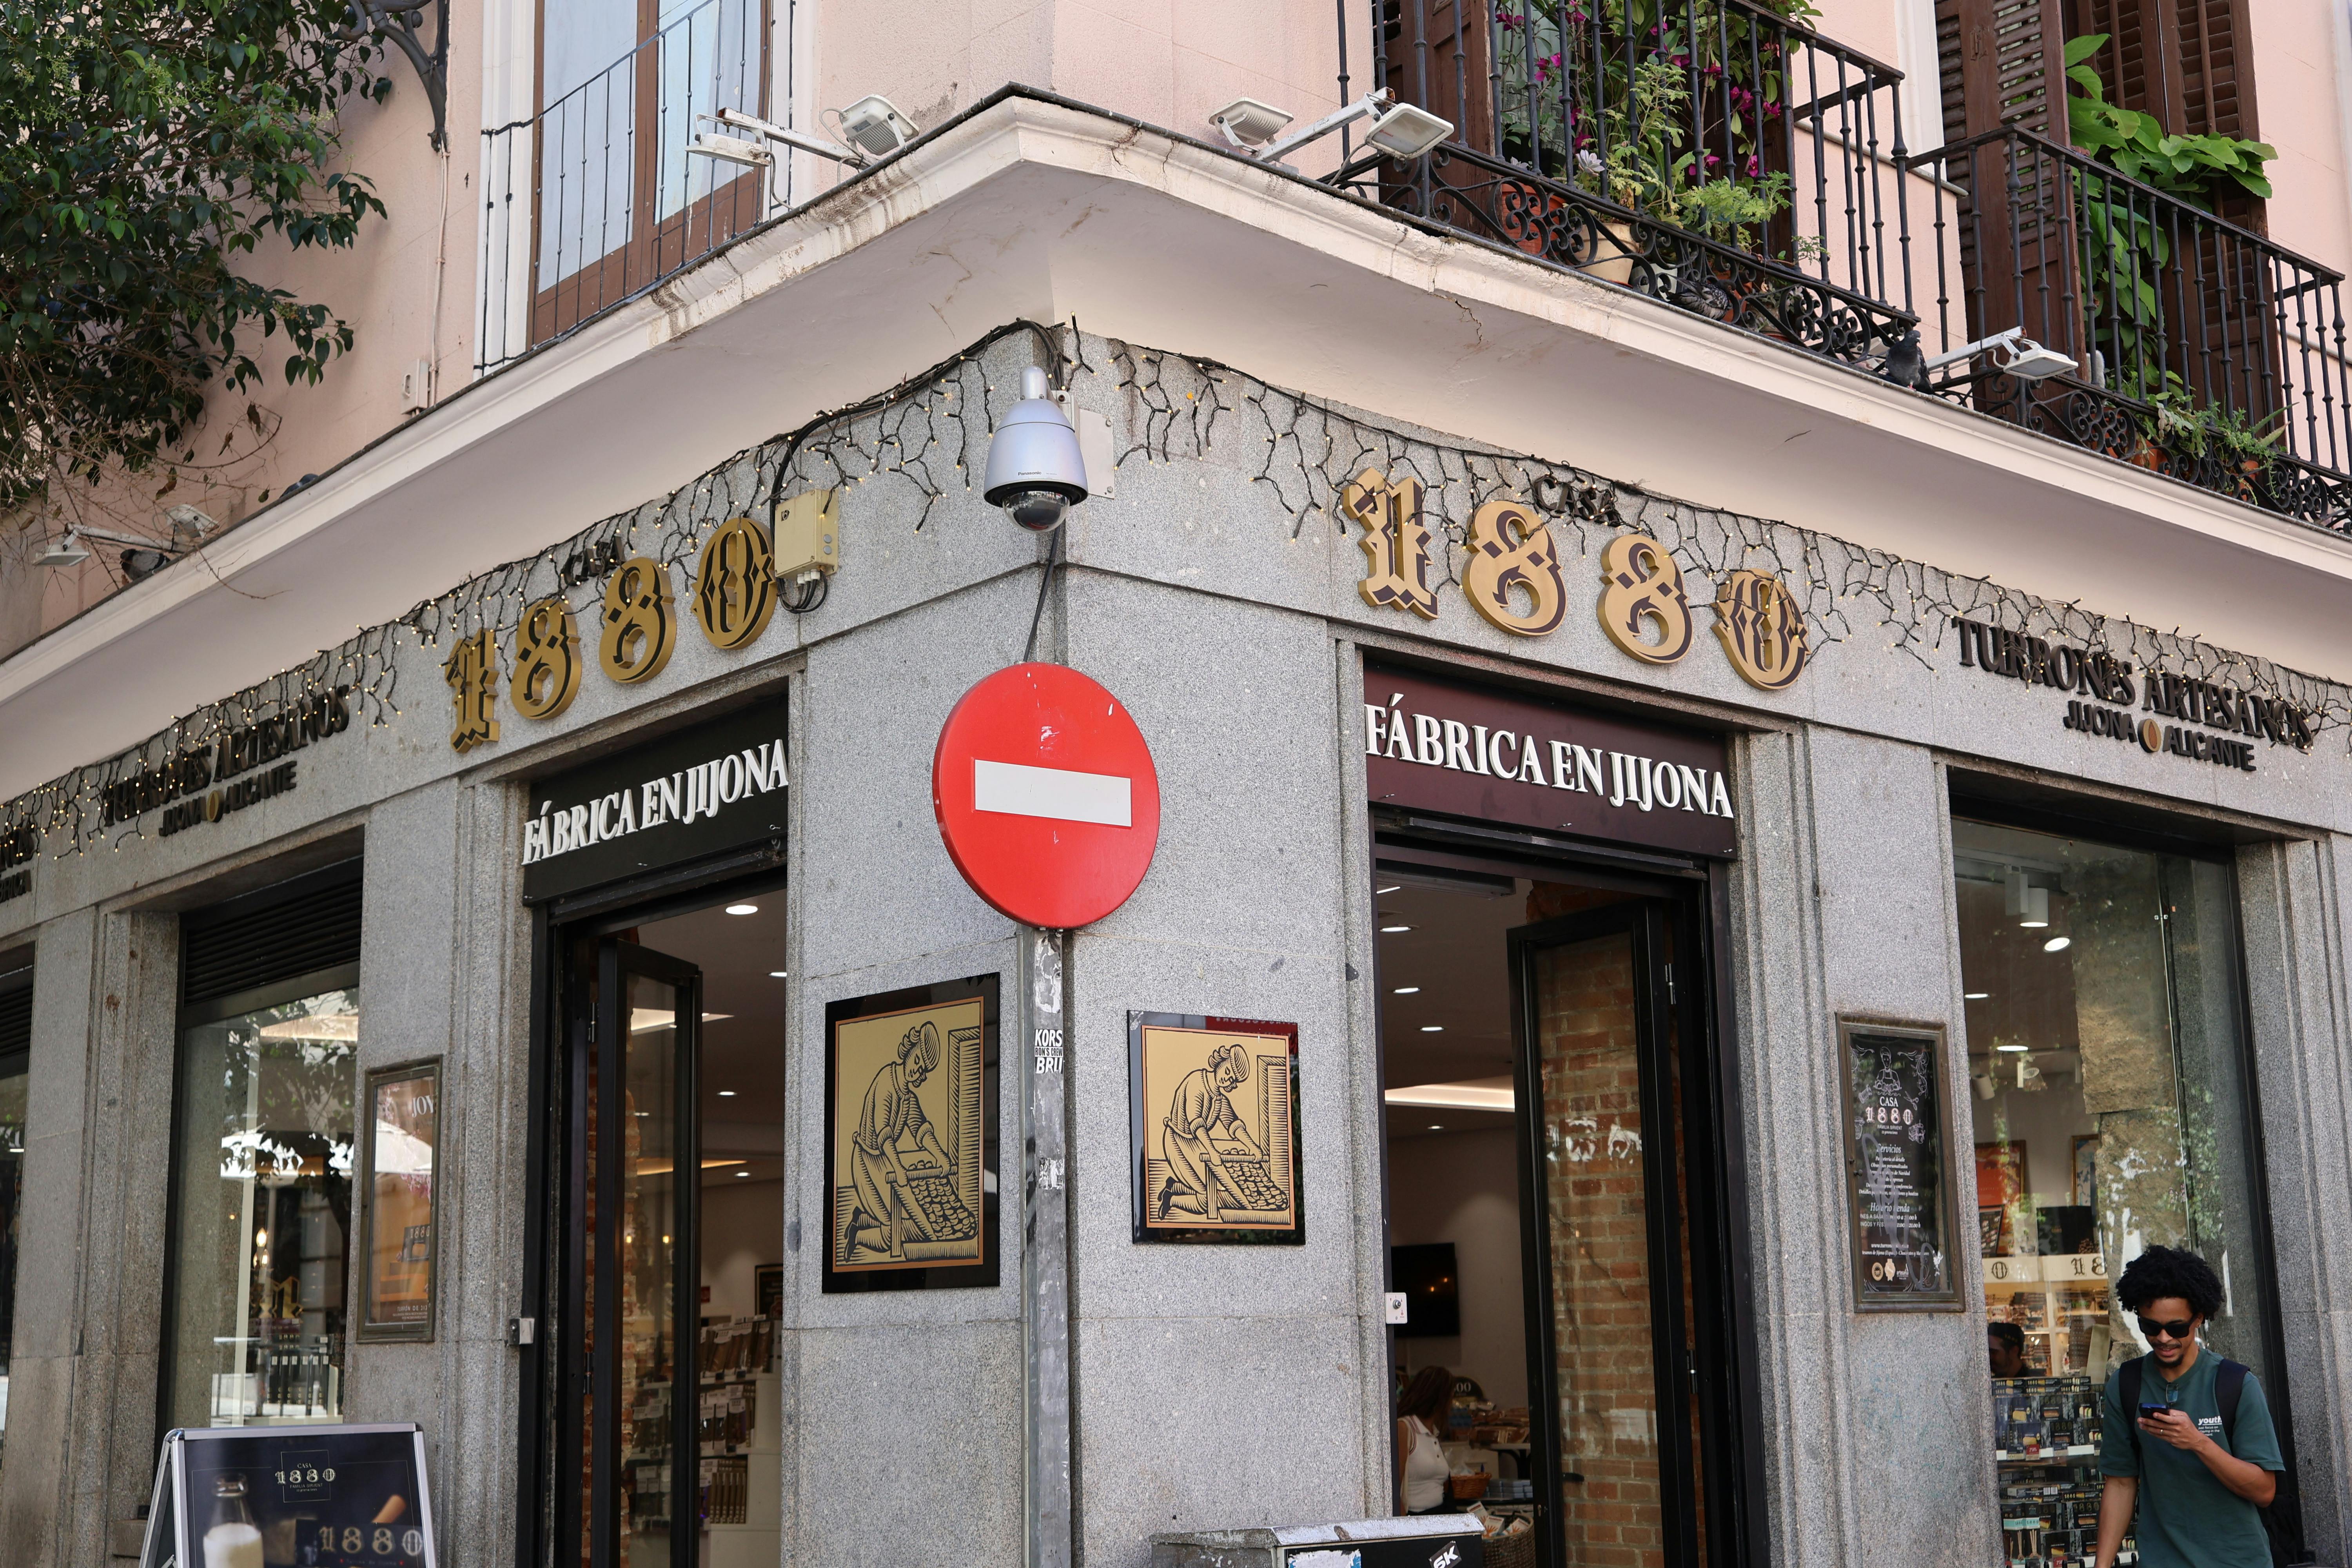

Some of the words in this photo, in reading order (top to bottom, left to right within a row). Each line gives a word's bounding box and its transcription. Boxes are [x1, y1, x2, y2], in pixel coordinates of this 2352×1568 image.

[1533, 474, 1621, 528] CASA
[561, 535, 626, 586] CASA
[1342, 466, 1811, 691] 1880
[445, 517, 779, 753] 1880
[1951, 616, 2136, 705] TURRONES
[2142, 668, 2311, 749] ARTESANOS
[103, 745, 212, 826] TURRONES
[213, 684, 349, 782] ARTESANOS
[1364, 693, 1547, 786] FÁBRICA
[1548, 740, 1603, 796] EN
[1609, 751, 1735, 819] JIJONA
[2063, 700, 2138, 742] JIJONA
[2162, 725, 2257, 771] ALICANTE
[159, 796, 207, 837] JIJONA
[223, 761, 297, 814] ALICANTE
[521, 788, 639, 866] FÁBRICA
[640, 772, 686, 830] EN
[682, 739, 789, 825] JIJONA
[1035, 1029, 1063, 1047] KORS
[1035, 1047, 1049, 1056] RON'S
[1051, 1048, 1063, 1056] CREW
[1866, 1106, 1914, 1125] 1880
[1880, 1096, 1899, 1107] CASA
[1870, 1202, 1892, 1212] Horio
[1893, 1203, 1910, 1212] enda
[2198, 1416, 2222, 1425] youth
[275, 1468, 336, 1485] 1880
[318, 1526, 423, 1556] 1880
